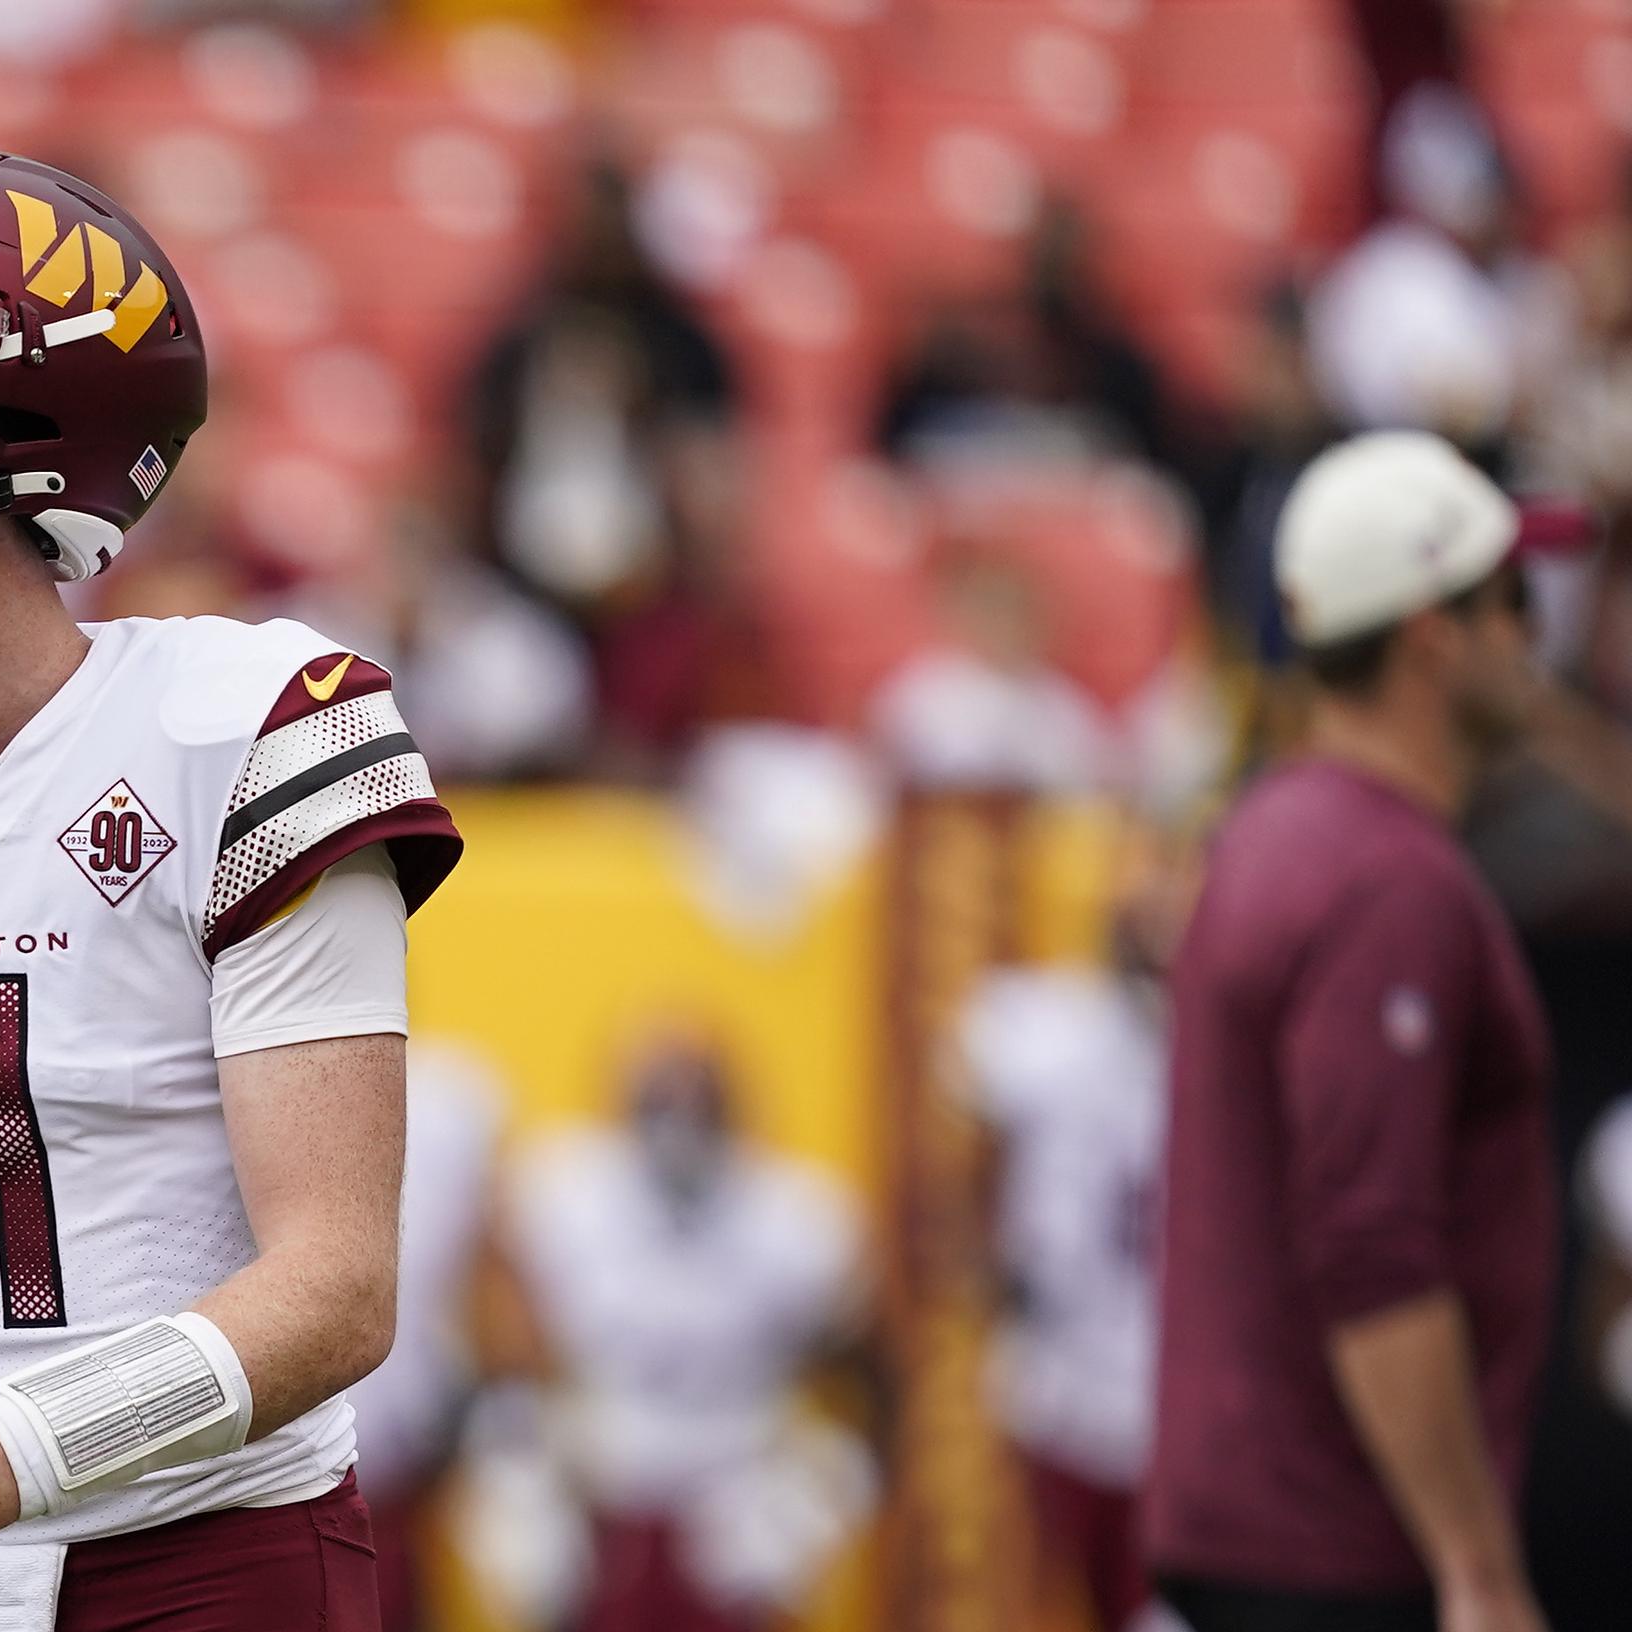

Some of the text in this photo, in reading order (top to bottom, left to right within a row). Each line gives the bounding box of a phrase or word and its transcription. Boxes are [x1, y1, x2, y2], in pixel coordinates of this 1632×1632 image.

[66, 811, 169, 873] 1932 90 2022
[99, 875, 128, 887] YEARS
